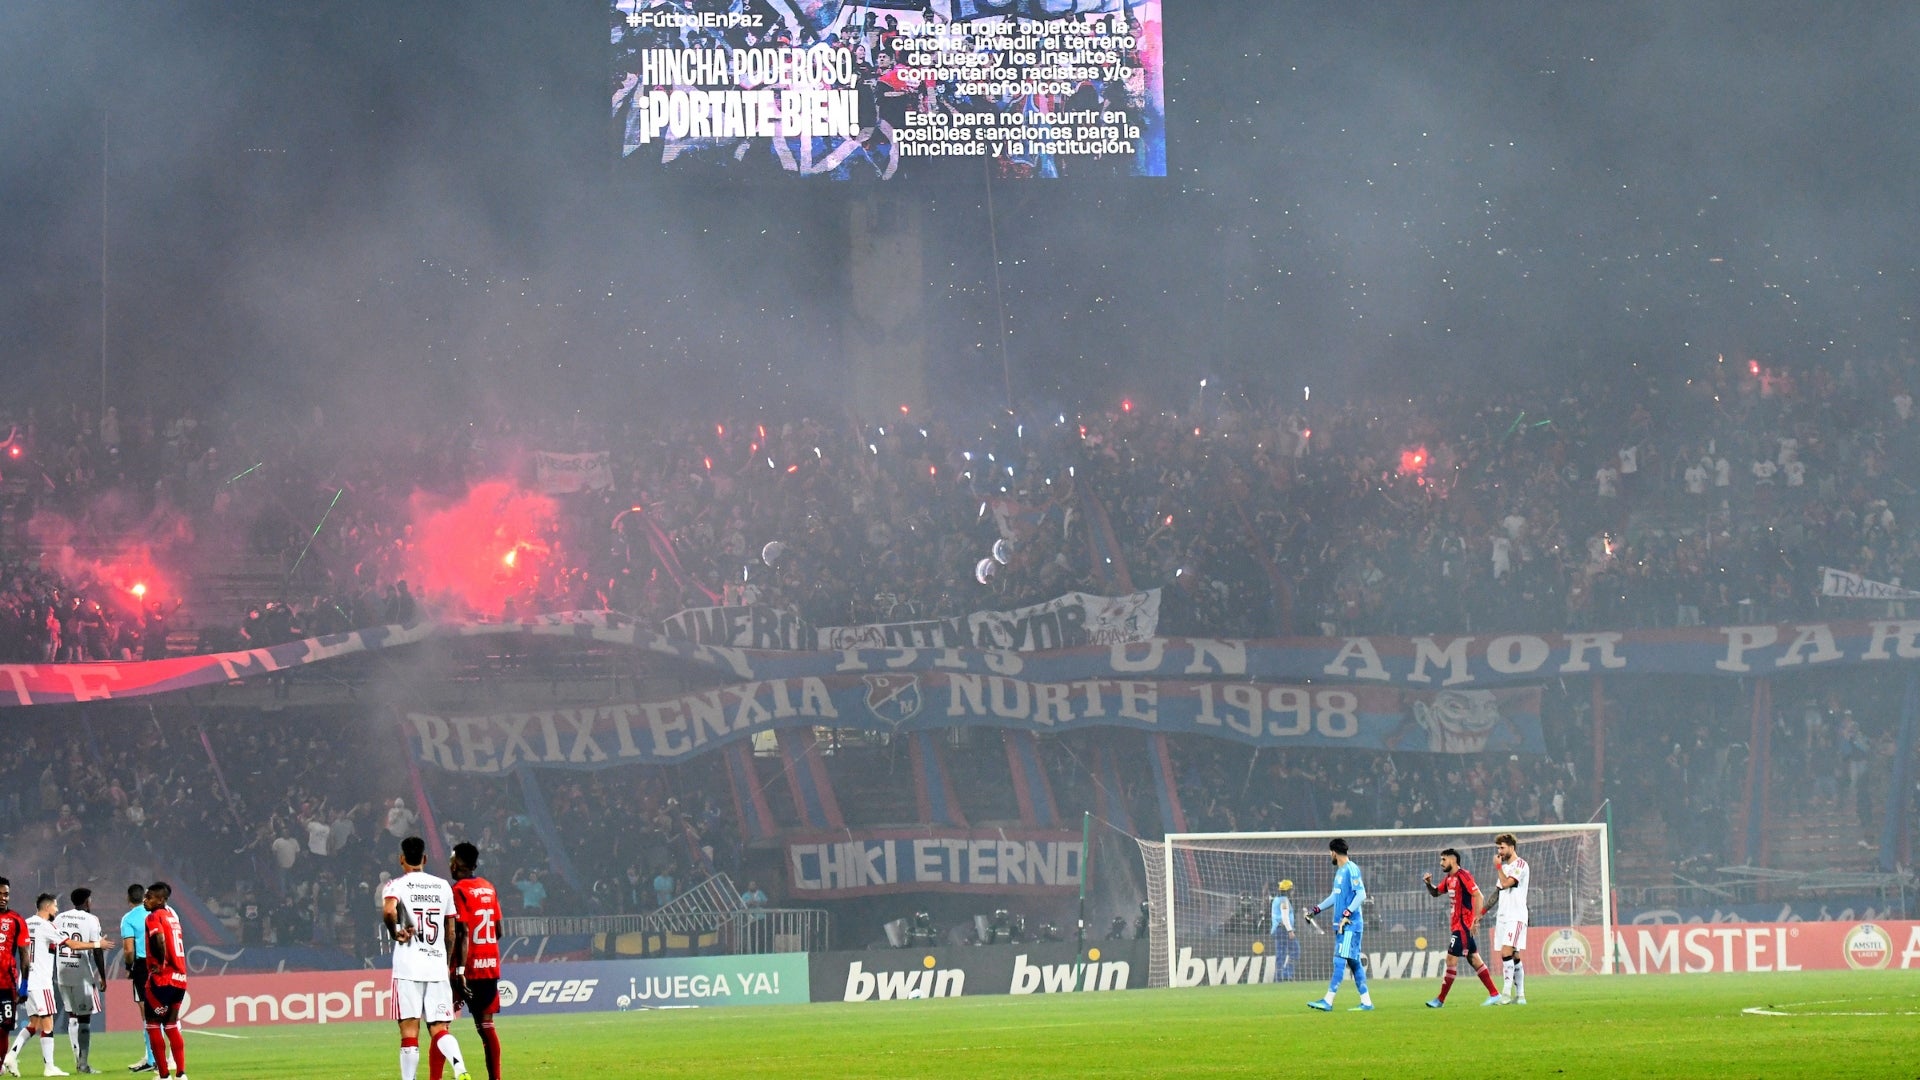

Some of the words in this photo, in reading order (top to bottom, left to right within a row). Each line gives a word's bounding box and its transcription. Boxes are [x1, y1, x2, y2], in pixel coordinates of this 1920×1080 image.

[626, 10, 763, 28] #FútbolEnPaz
[898, 20, 949, 36] Evita
[951, 20, 1016, 37] arrojar
[1020, 19, 1091, 37] objetos
[1095, 22, 1107, 35] a
[1111, 19, 1129, 35] la
[891, 35, 967, 52] cancha,
[975, 34, 1040, 50] invadir
[1043, 34, 1061, 50] el
[1065, 34, 1136, 50] terreno
[907, 50, 932, 66] de
[937, 50, 989, 68] juego
[991, 53, 1005, 68] y
[1008, 50, 1037, 66] los
[1041, 49, 1121, 68] insultos,
[641, 48, 729, 86] HINCHA
[733, 47, 858, 89] PODEROSO,
[896, 65, 1018, 82] comentarios
[1022, 65, 1100, 80] racistas
[1102, 64, 1132, 82] y/o
[639, 90, 775, 144] ¡PORTATE
[780, 89, 860, 137] BIEN!
[892, 125, 971, 144] posibles
[975, 124, 1073, 141] sanciones
[1076, 125, 1120, 142] para
[1123, 123, 1141, 139] la
[904, 111, 948, 126] Esto
[952, 112, 996, 128] para
[1000, 112, 1024, 126] no
[1028, 110, 1100, 126] incurrir
[1103, 110, 1127, 125] en
[900, 139, 987, 157] hinchada
[991, 143, 1005, 158] y
[1007, 140, 1024, 156] la
[1028, 139, 1136, 156] institución.
[1323, 631, 1627, 687] AMOR
[946, 672, 1159, 726] NORTE
[1197, 684, 1360, 738] 1998
[406, 676, 839, 774] REXIXTENXIA
[790, 839, 898, 890] CHIKI
[912, 838, 1089, 886] ETERNO
[412, 908, 441, 945] 15
[473, 908, 498, 945] 26
[1599, 926, 1802, 974] AMSTEL
[630, 973, 732, 1001] ¡JUEGA
[735, 971, 780, 996] YA!
[844, 955, 966, 1002] bwin
[1009, 947, 1131, 995] bwin
